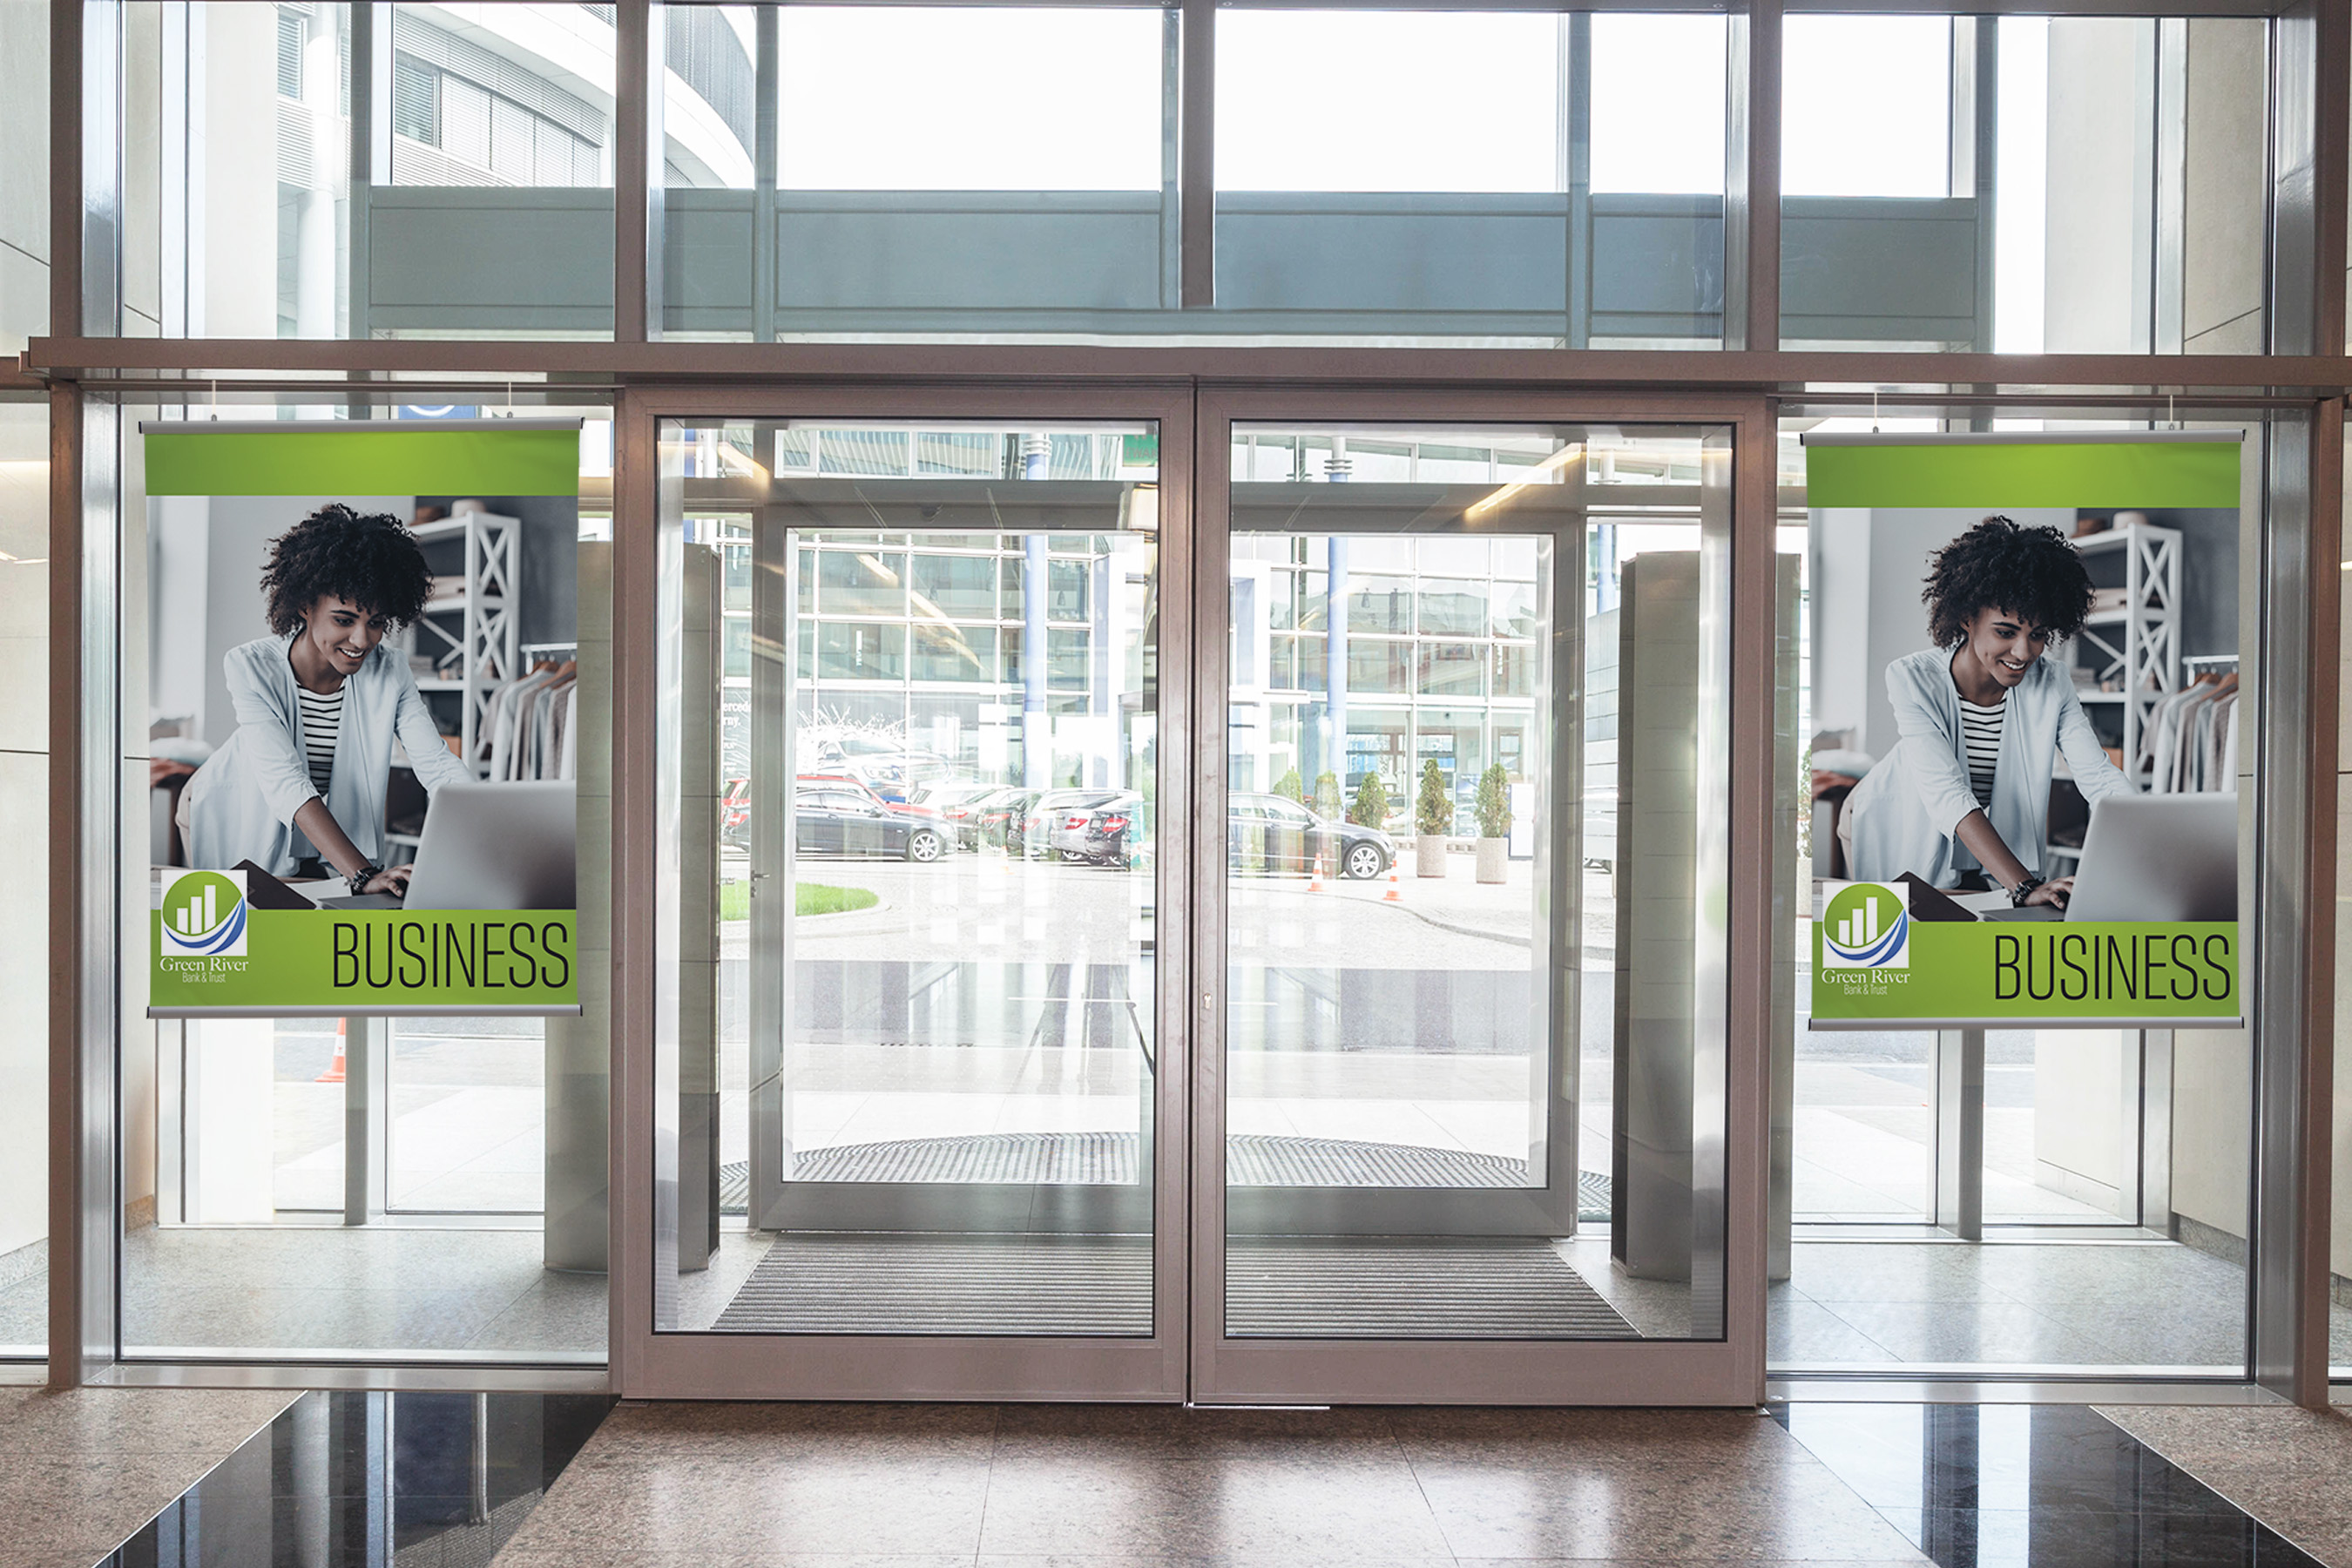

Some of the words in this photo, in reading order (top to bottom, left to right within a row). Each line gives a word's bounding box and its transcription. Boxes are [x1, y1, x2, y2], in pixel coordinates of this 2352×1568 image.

[333, 922, 570, 989] BUSINESS
[159, 956, 205, 972] Green
[210, 956, 249, 972] River
[1995, 934, 2232, 1001] BUSINESS
[182, 972, 200, 983] Bank
[201, 972, 207, 983] &
[209, 972, 226, 983] Trust
[1821, 969, 1867, 983] Green
[1871, 969, 1910, 983] River
[1843, 984, 1862, 995] Bank
[1862, 984, 1869, 995] &
[1870, 984, 1888, 995] Trust
